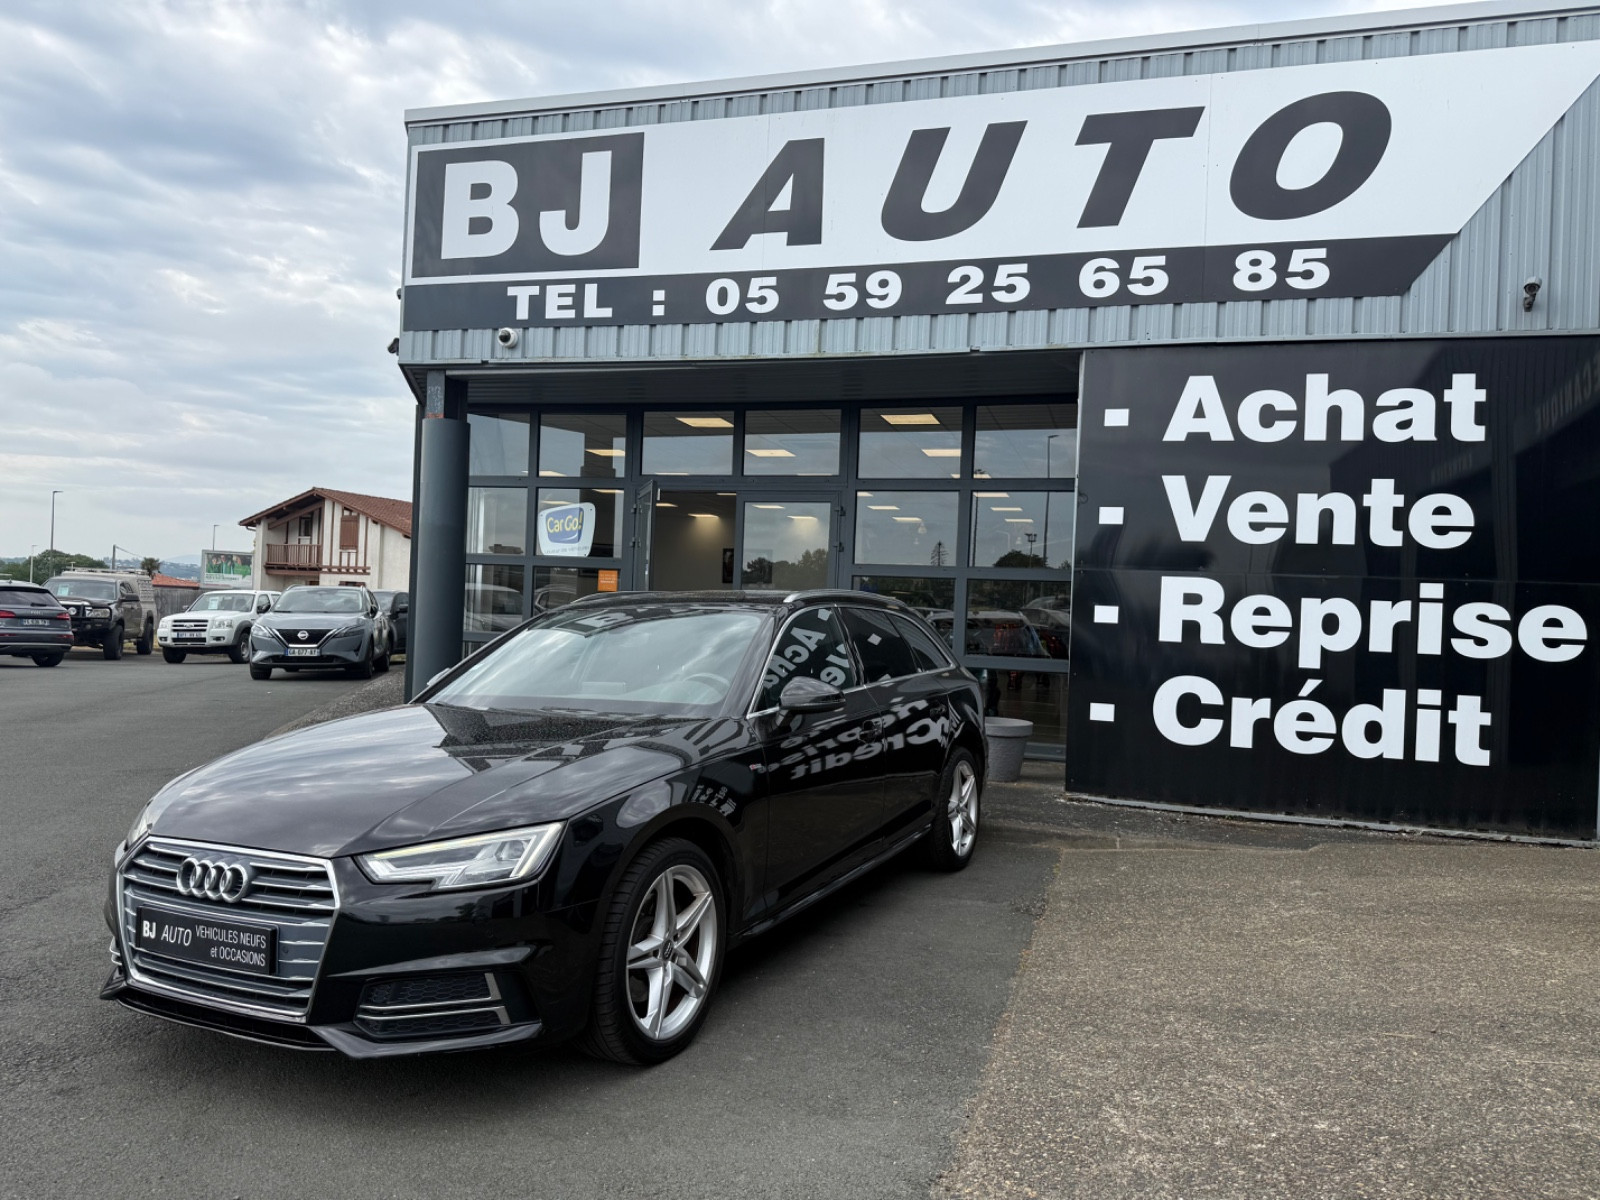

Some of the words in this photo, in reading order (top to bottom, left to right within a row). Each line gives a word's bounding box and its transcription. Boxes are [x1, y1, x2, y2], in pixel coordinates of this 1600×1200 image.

[440, 150, 613, 260] BJ
[709, 91, 1392, 250] AUTO
[506, 283, 613, 321] TEL
[705, 276, 780, 316] 05
[822, 269, 903, 311] 59
[945, 263, 1031, 305] 25
[1078, 255, 1169, 298] 65
[1232, 247, 1331, 292] 85
[1161, 373, 1487, 443] Achat
[1161, 475, 1475, 549] Vente
[1158, 575, 1588, 669] Reprise
[1152, 675, 1492, 767] Crédit
[142, 920, 157, 939] BJ
[161, 924, 193, 946] AUTO
[195, 924, 239, 944] VEHICULES
[239, 933, 267, 949] NEUFS
[210, 946, 218, 958] et
[218, 948, 266, 967] OCCASIONS
